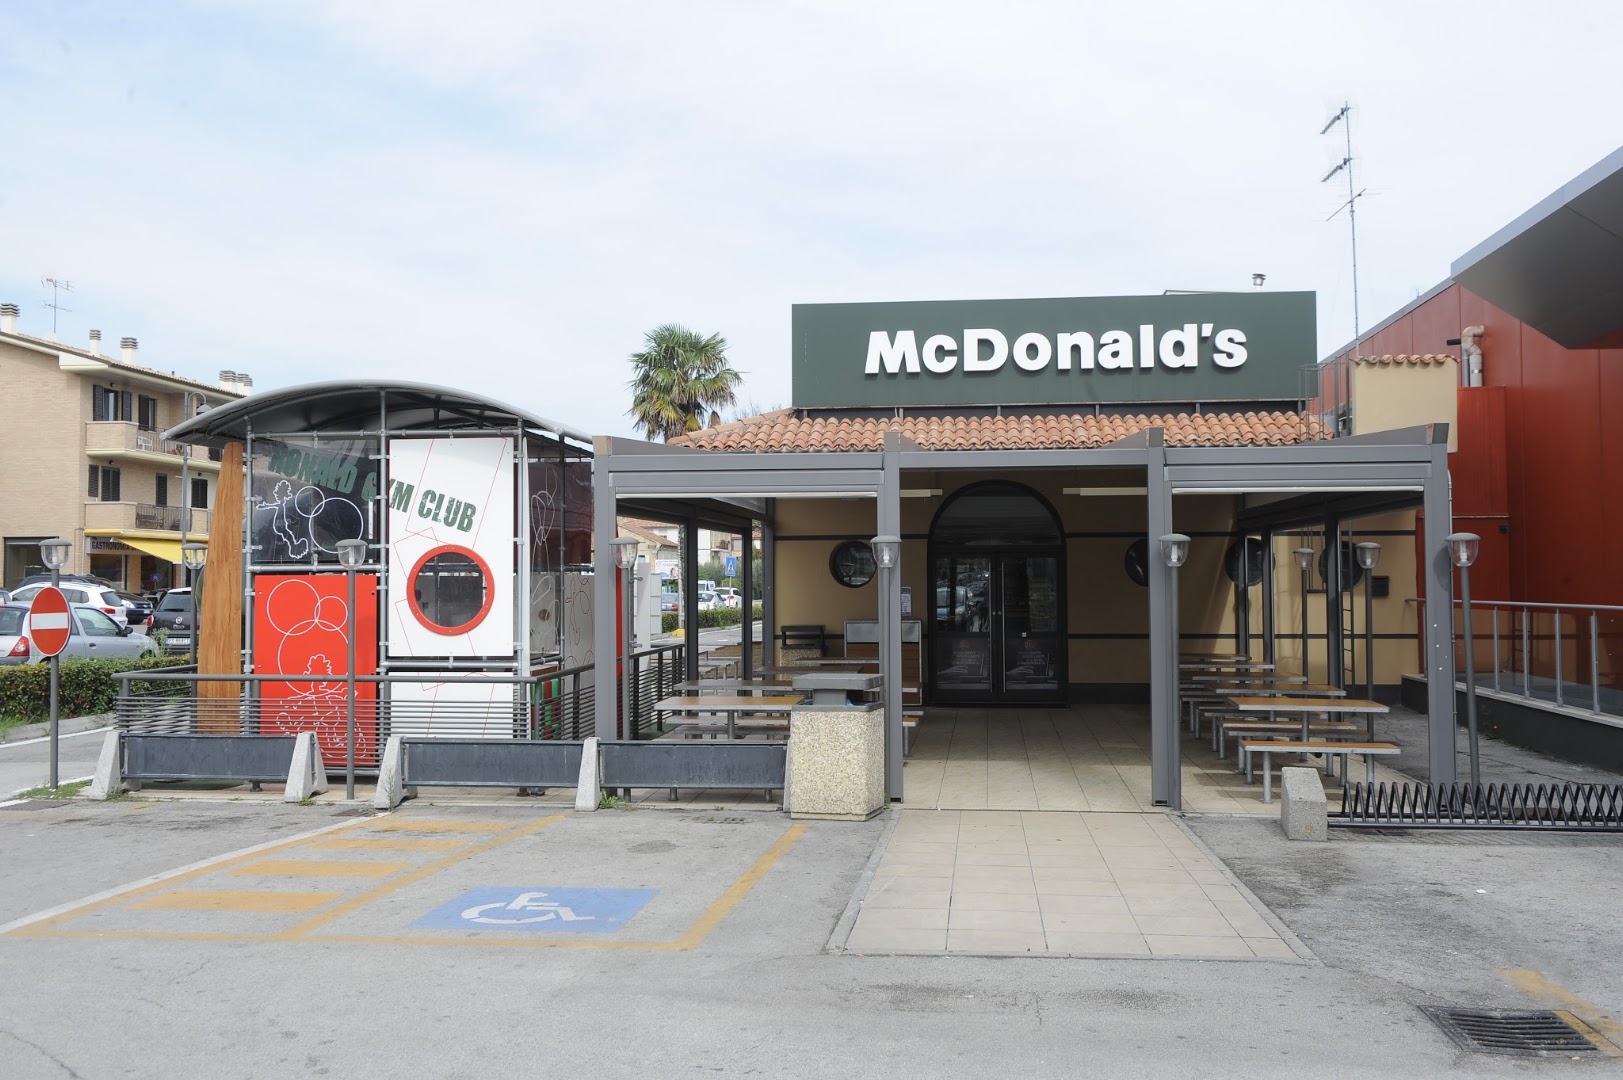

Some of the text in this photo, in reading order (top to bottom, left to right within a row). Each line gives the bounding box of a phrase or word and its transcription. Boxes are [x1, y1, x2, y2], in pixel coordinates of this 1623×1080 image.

[865, 323, 1248, 374] McDonald's
[268, 445, 358, 494] RONALD
[418, 489, 477, 533] CLUB
[91, 541, 130, 551] GASTRONOMIA
